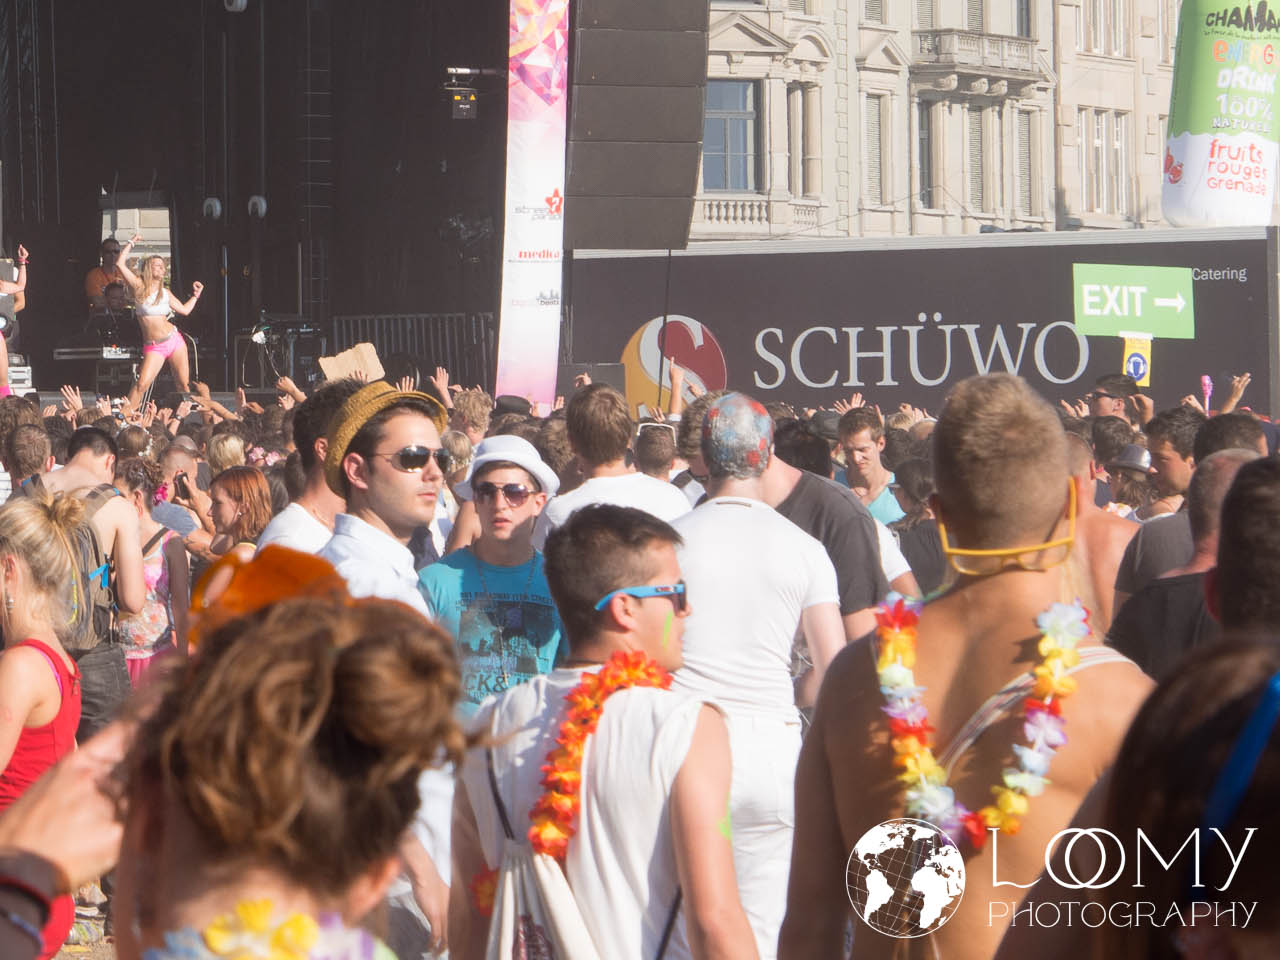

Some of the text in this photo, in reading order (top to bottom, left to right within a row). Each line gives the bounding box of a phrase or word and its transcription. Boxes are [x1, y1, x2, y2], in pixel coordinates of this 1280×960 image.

[1209, 139, 1264, 164] fruits
[1208, 161, 1268, 182] rouges
[1191, 267, 1248, 282] Catering
[1082, 284, 1148, 317] EXIT
[753, 312, 1090, 390] SCHÜWO
